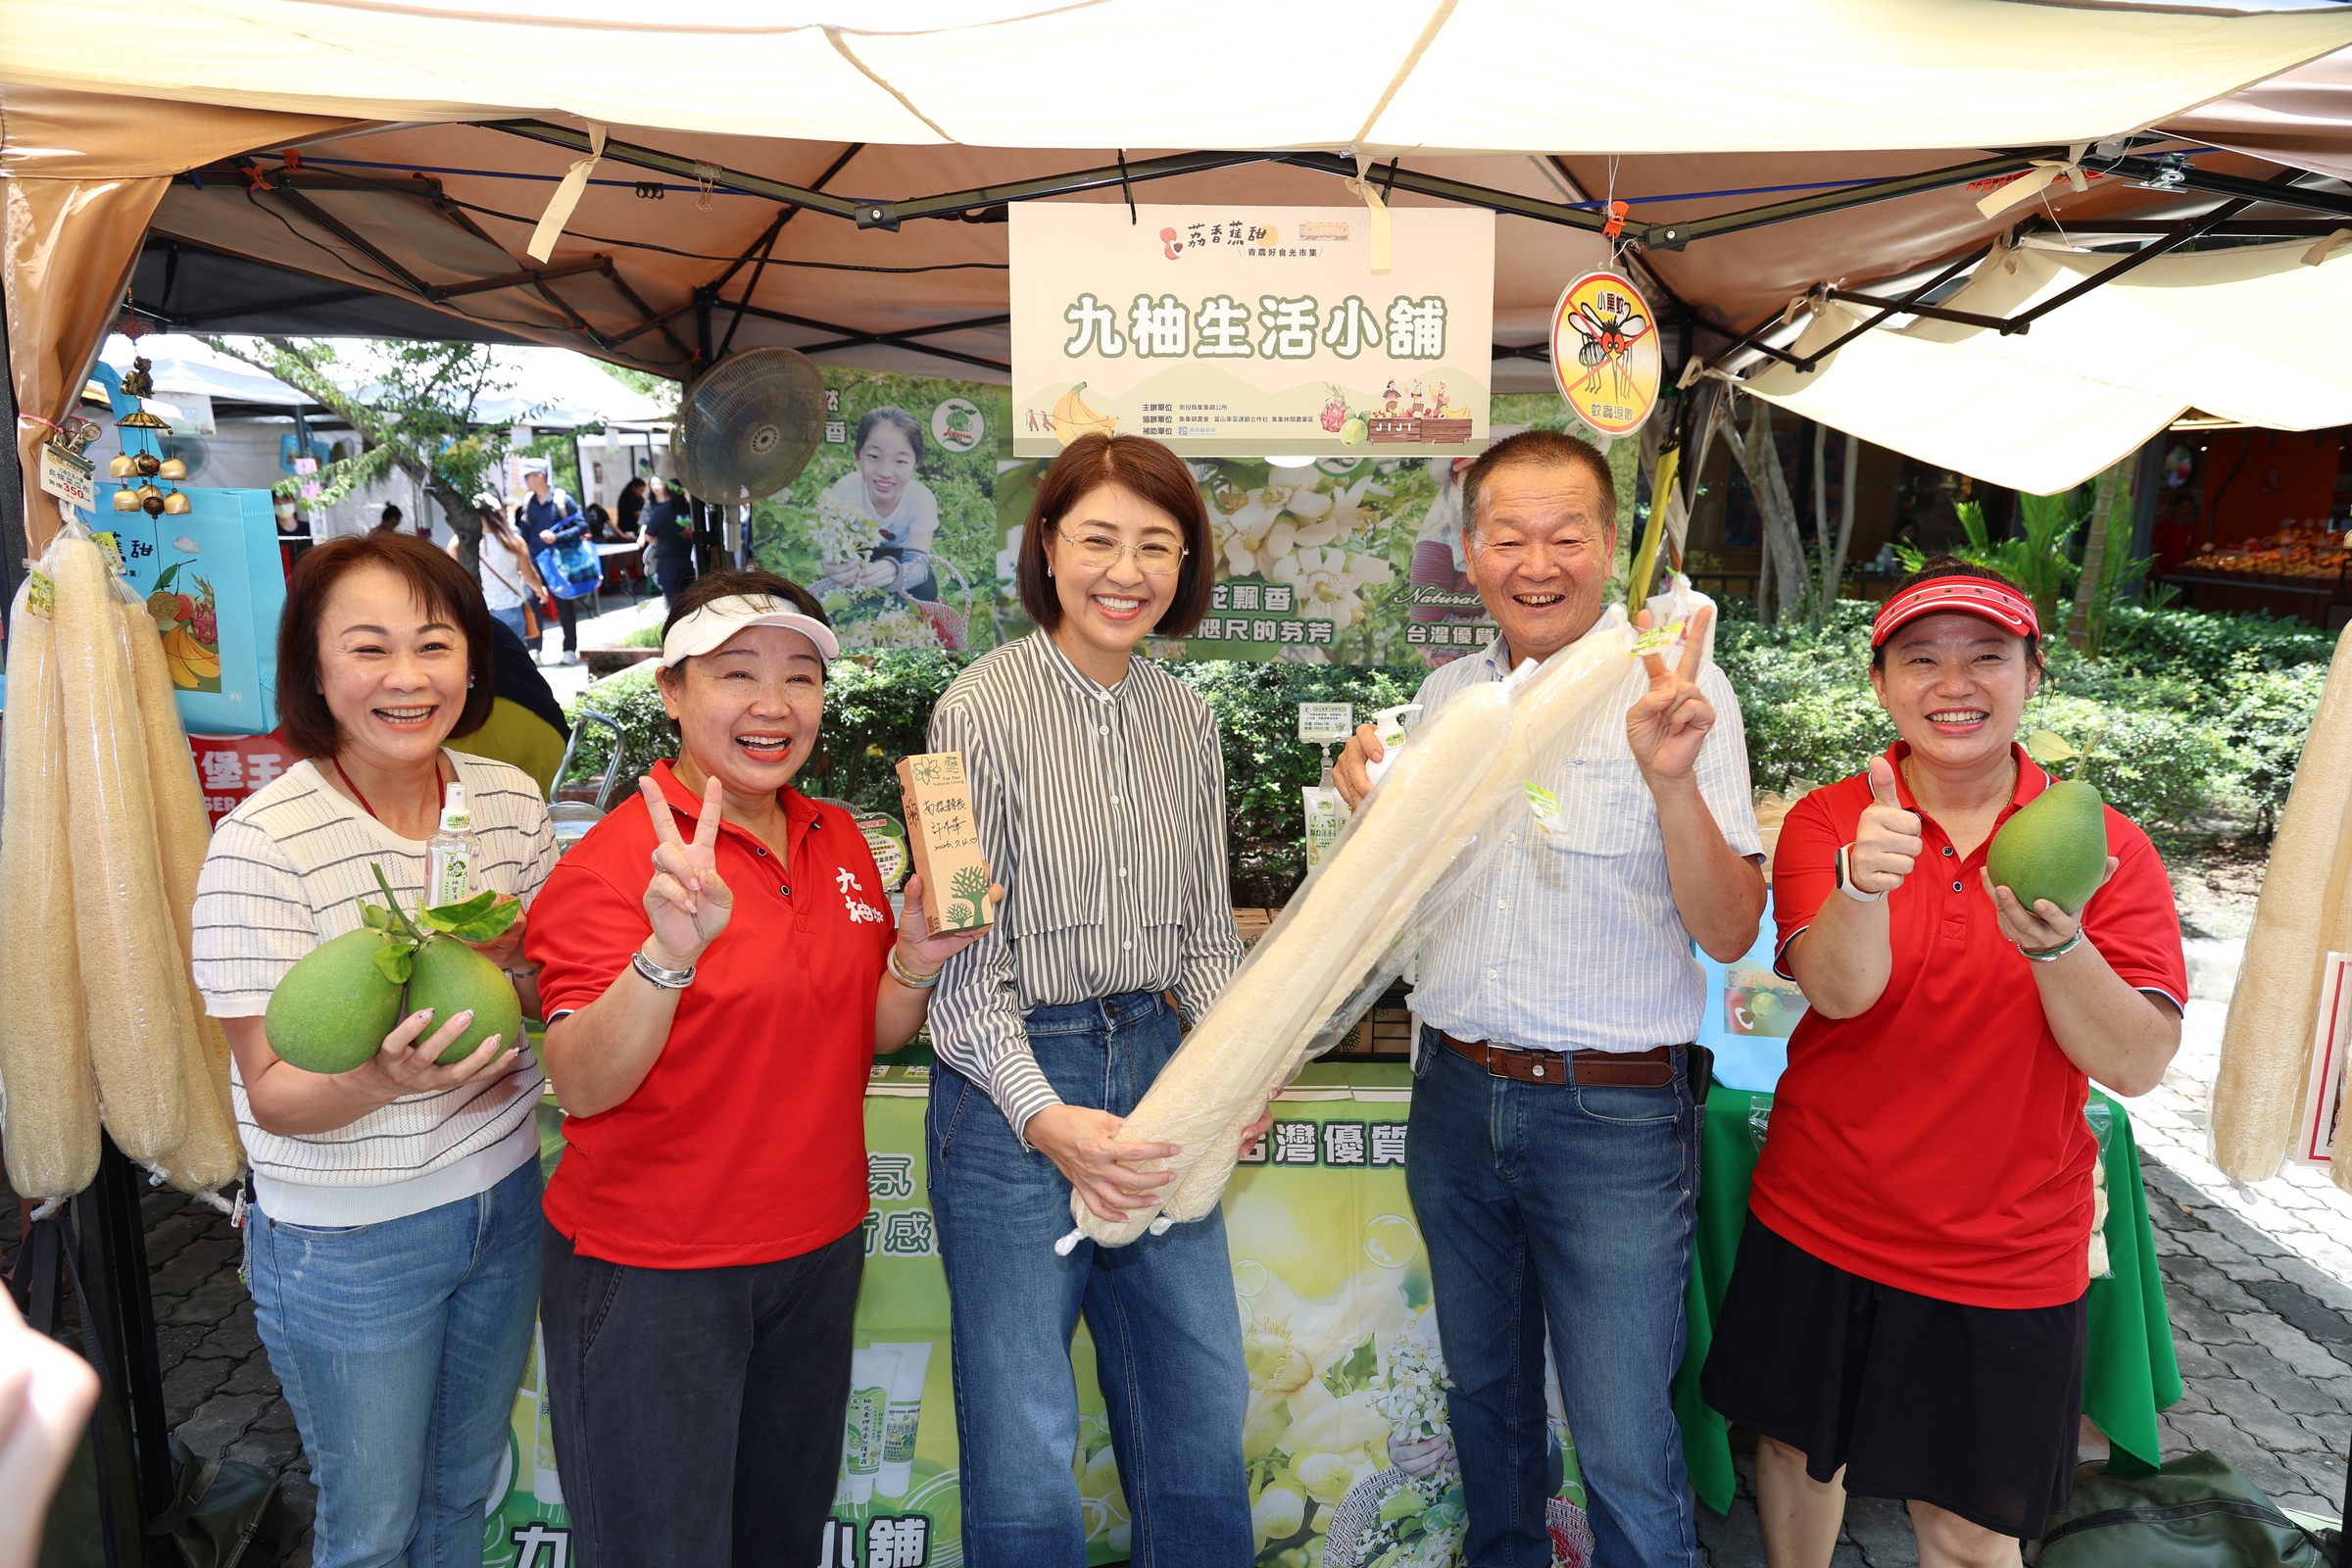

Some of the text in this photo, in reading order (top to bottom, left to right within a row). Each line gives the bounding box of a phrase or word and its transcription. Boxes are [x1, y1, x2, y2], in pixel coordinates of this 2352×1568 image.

[1188, 220, 1267, 248] 荔香蕉甜
[1248, 248, 1318, 258] 青農好食光市集
[1597, 291, 1625, 315] 小黑蚊
[1065, 293, 1446, 360] 九柚生活小舖
[1591, 403, 1634, 421] 蚊蟲退散
[825, 420, 846, 443] 香
[1375, 422, 1412, 432] JIJI
[63, 482, 84, 499] 350
[1393, 586, 1482, 608] Natural
[1146, 618, 1333, 644] 咫尺的芬芳
[1406, 624, 1502, 647] 台灣優質
[193, 751, 282, 790] 堡王
[836, 867, 874, 924] 九柚
